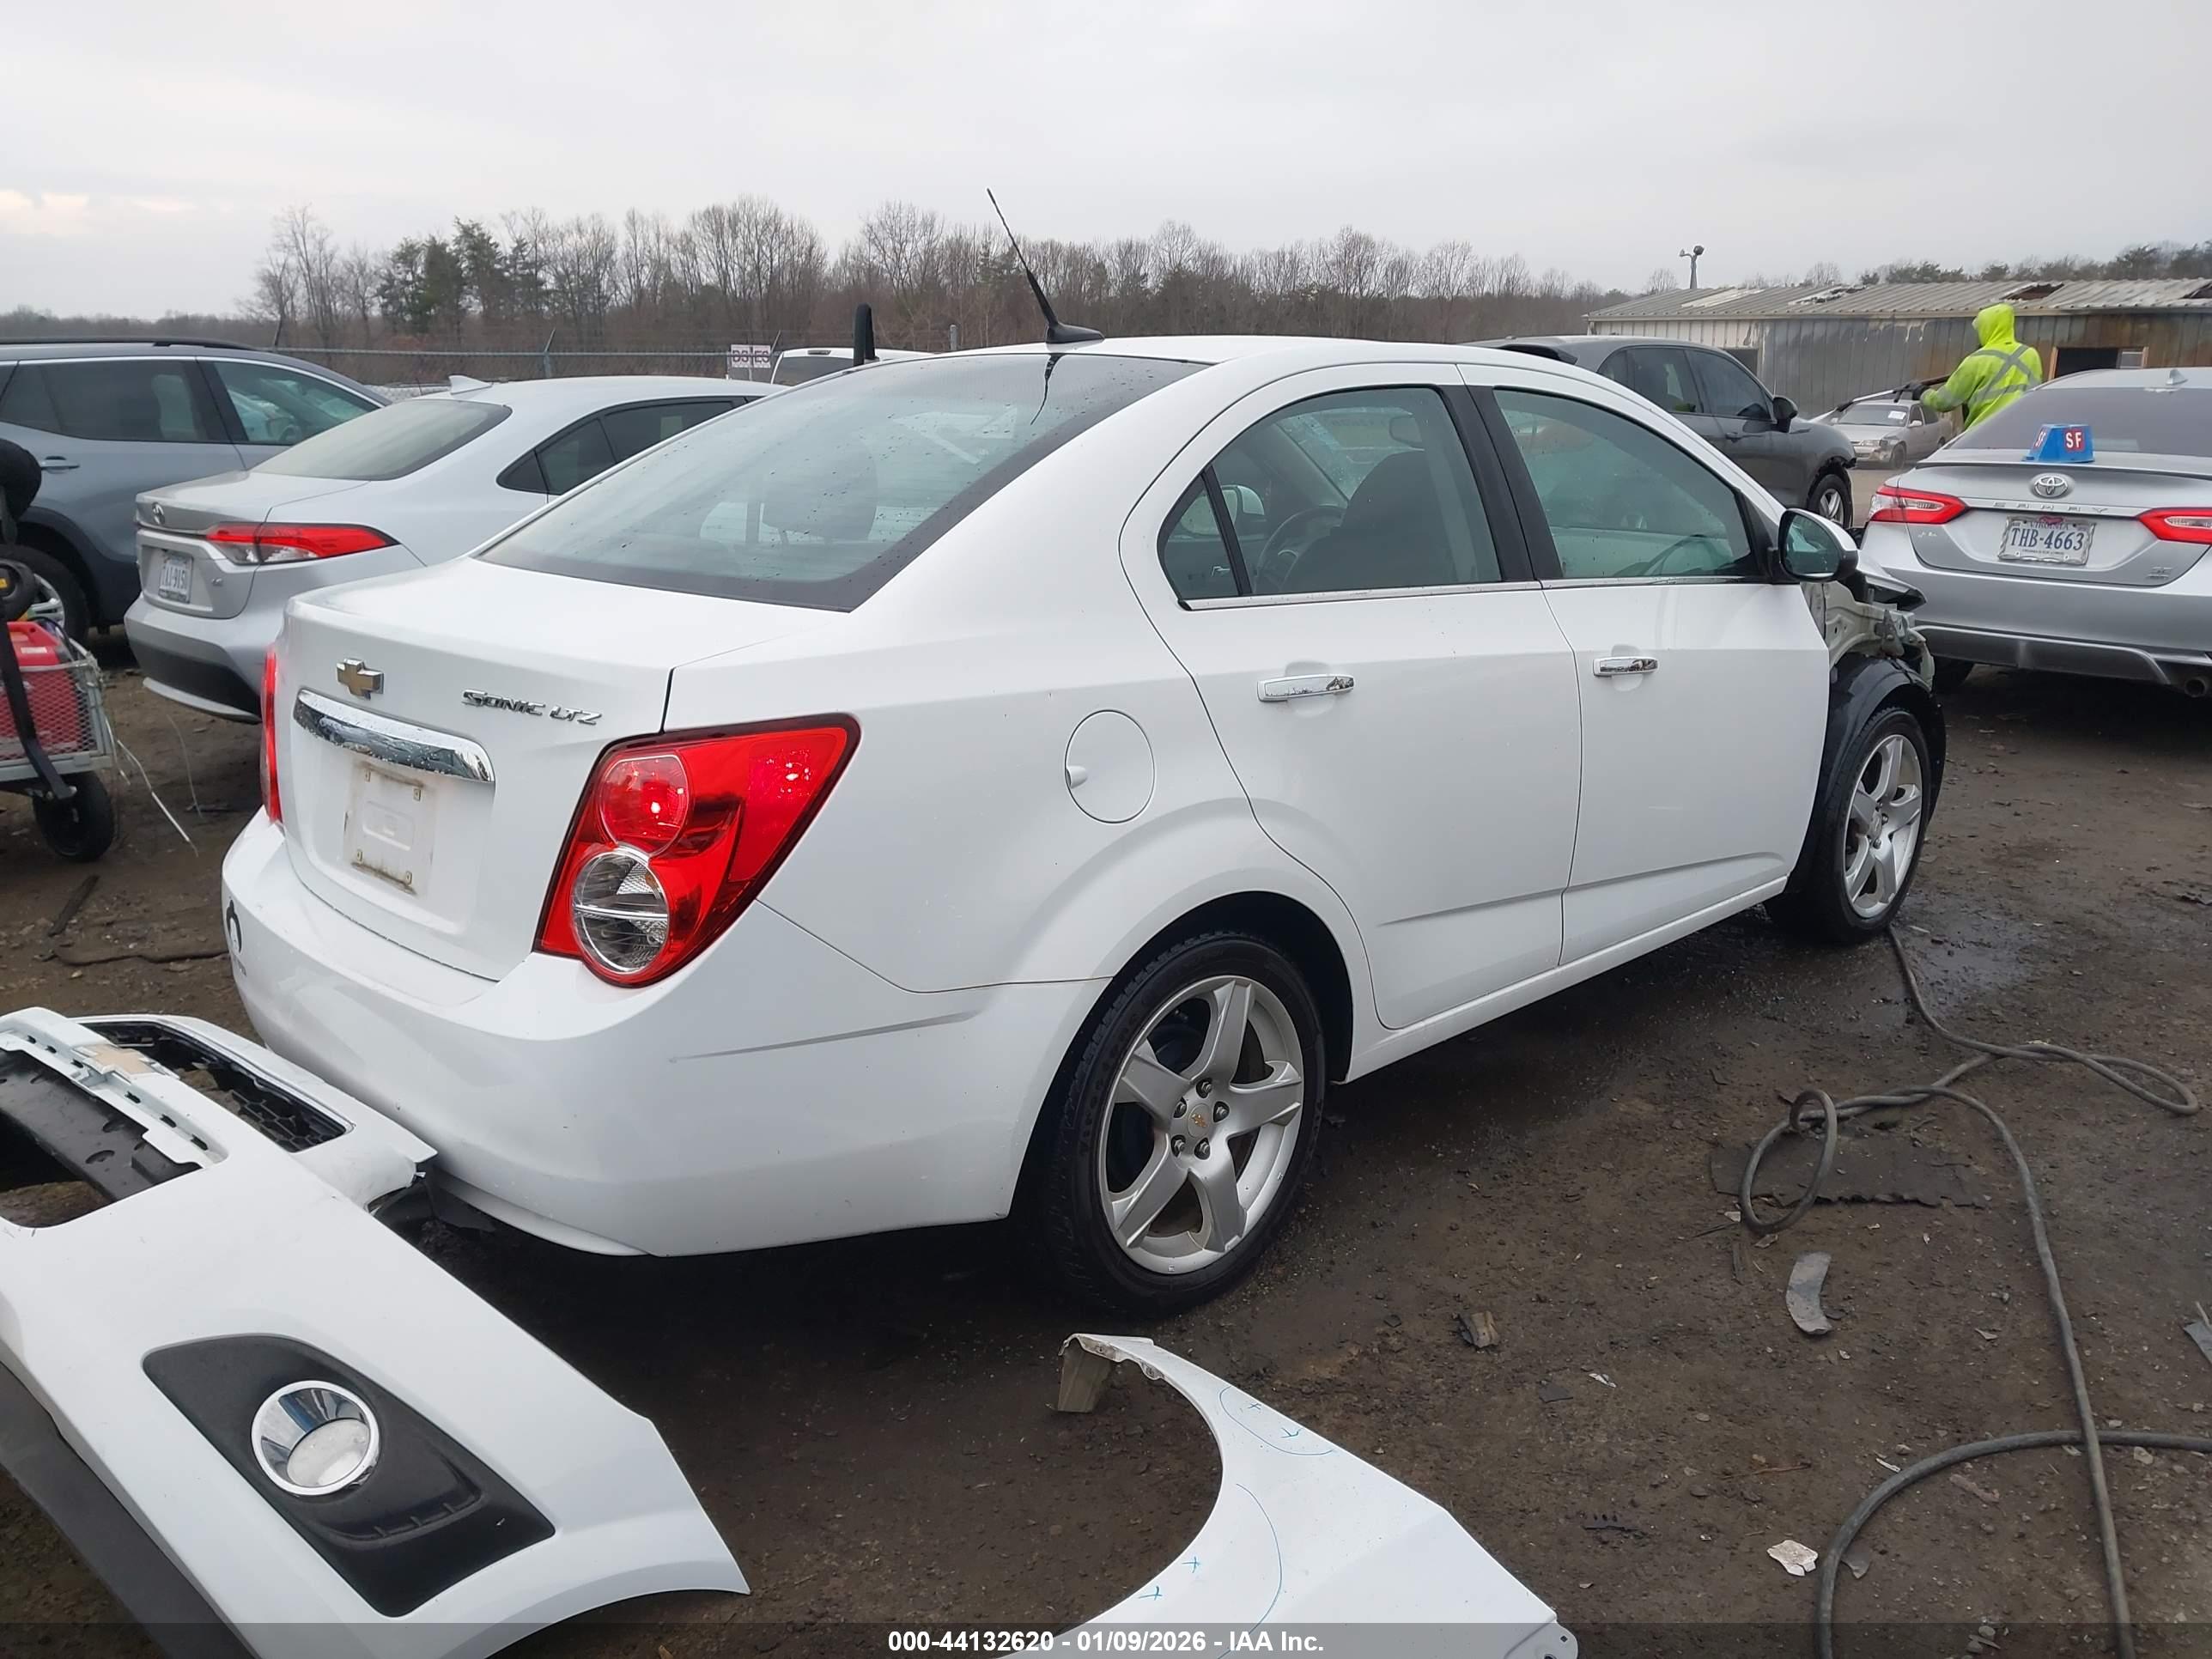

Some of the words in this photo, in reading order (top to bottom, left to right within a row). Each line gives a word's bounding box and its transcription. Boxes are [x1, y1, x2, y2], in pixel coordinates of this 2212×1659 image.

[2065, 432, 2082, 448] SF
[2010, 527, 2085, 550] THB-4663
[549, 704, 603, 726] LTZ
